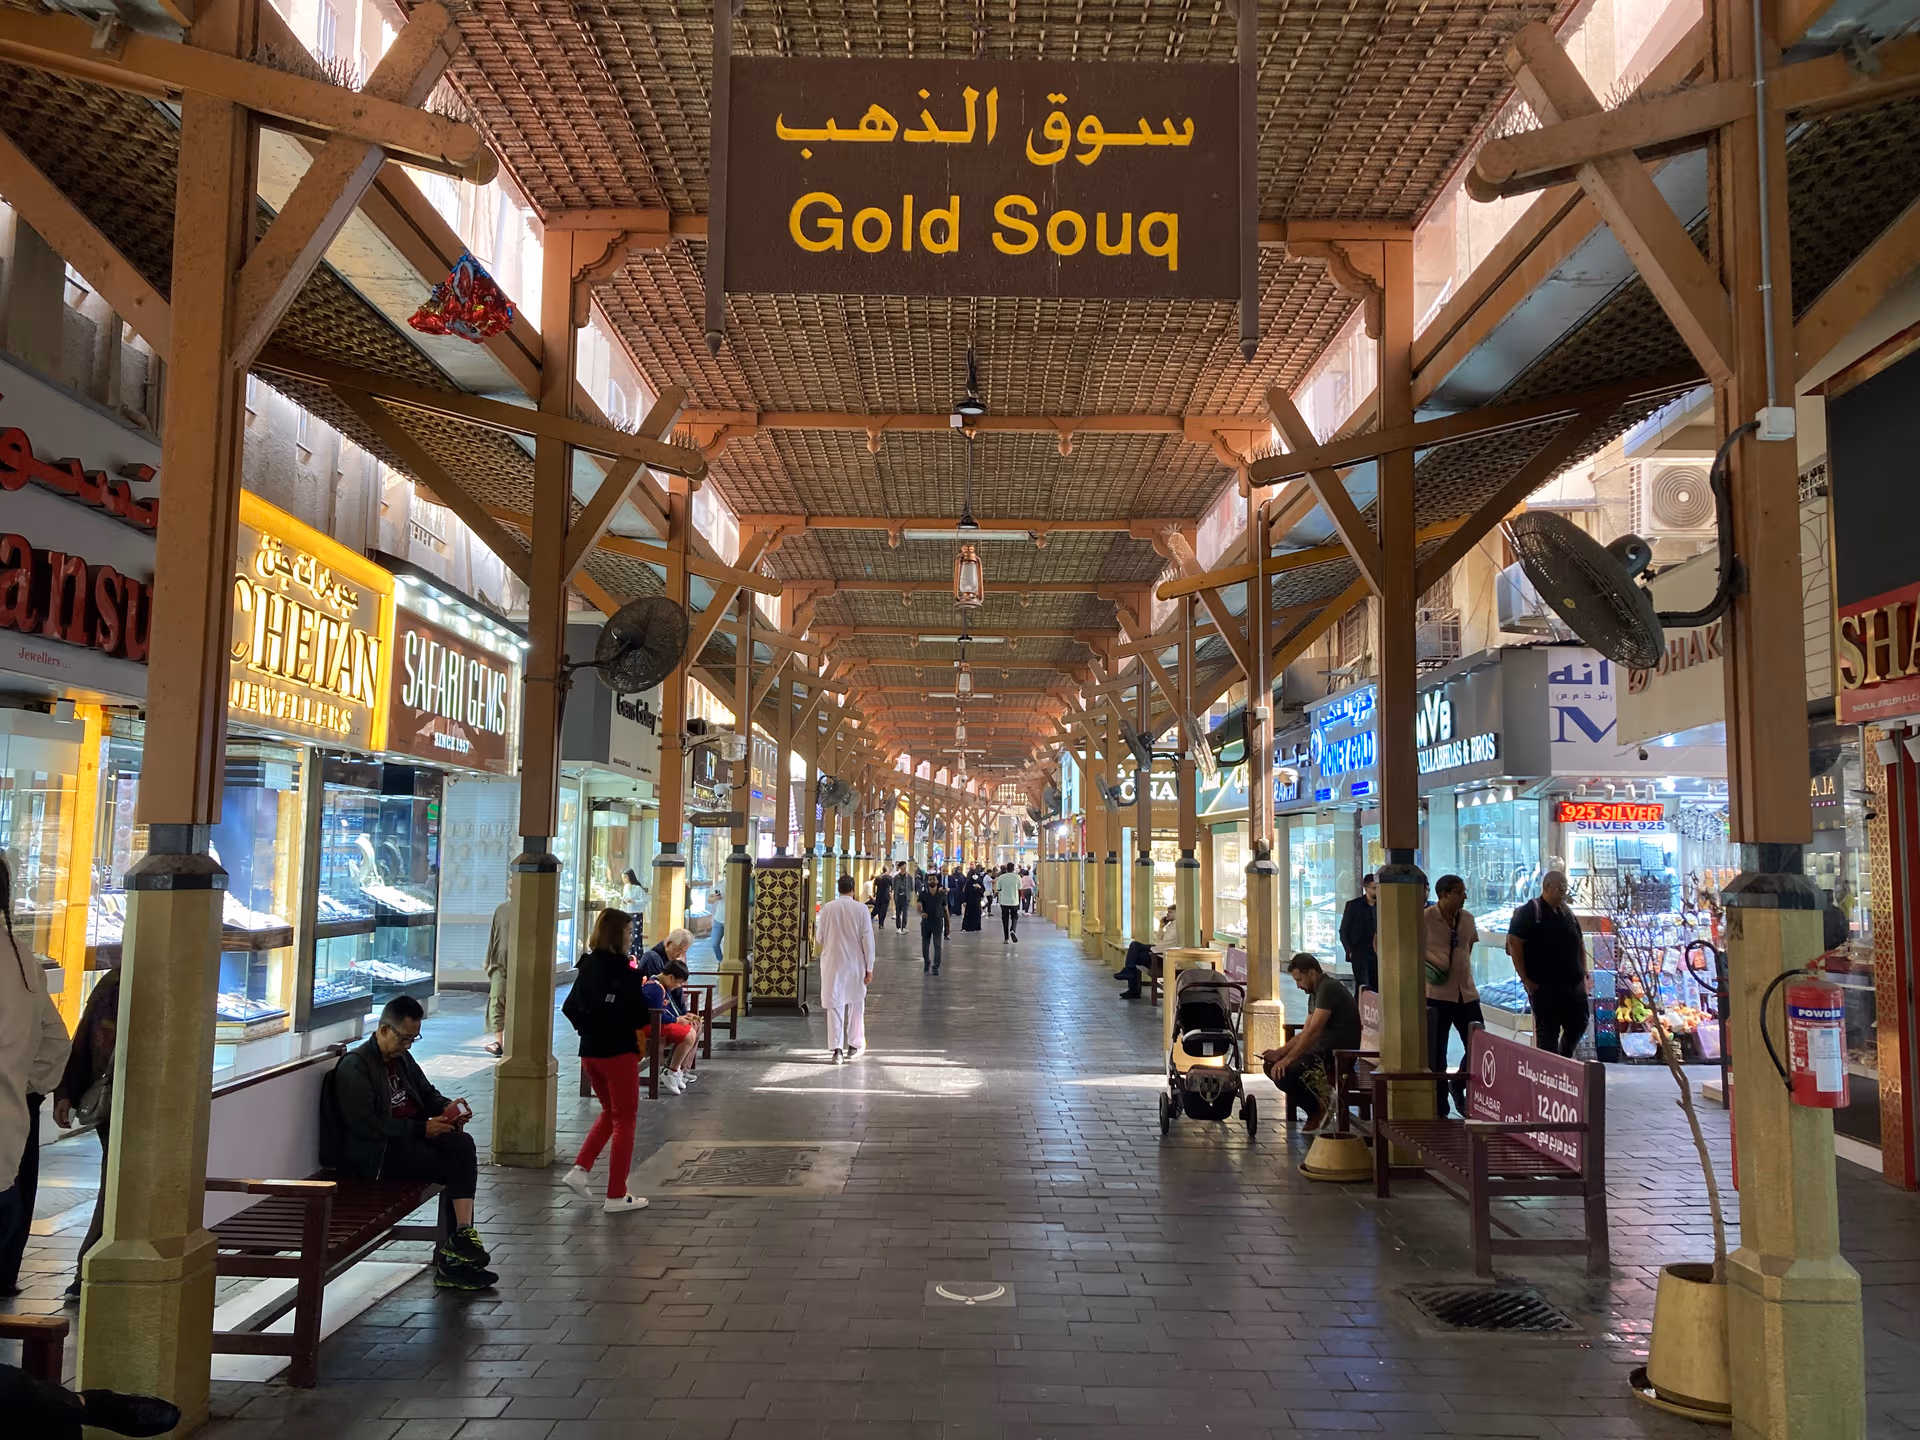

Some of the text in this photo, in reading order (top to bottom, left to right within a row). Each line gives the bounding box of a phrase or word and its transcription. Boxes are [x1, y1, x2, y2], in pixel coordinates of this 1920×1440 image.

[775, 85, 1196, 167] سوق الذهب
[788, 192, 1179, 271] Gold Souq
[230, 572, 382, 709] CHETAN
[18, 647, 61, 667] Jewellers
[402, 630, 507, 736] SAFARI GEMS
[228, 678, 353, 735] JEWELLERS
[434, 732, 455, 750] SINCE
[1320, 730, 1377, 776] HONEY GOLD
[1470, 732, 1496, 763] BROS
[1564, 805, 1660, 821] 925 SILVER
[1577, 821, 1666, 830] SILVER 925
[1474, 1090, 1501, 1113] MALABAR
[1537, 1094, 1578, 1123] 12,000
